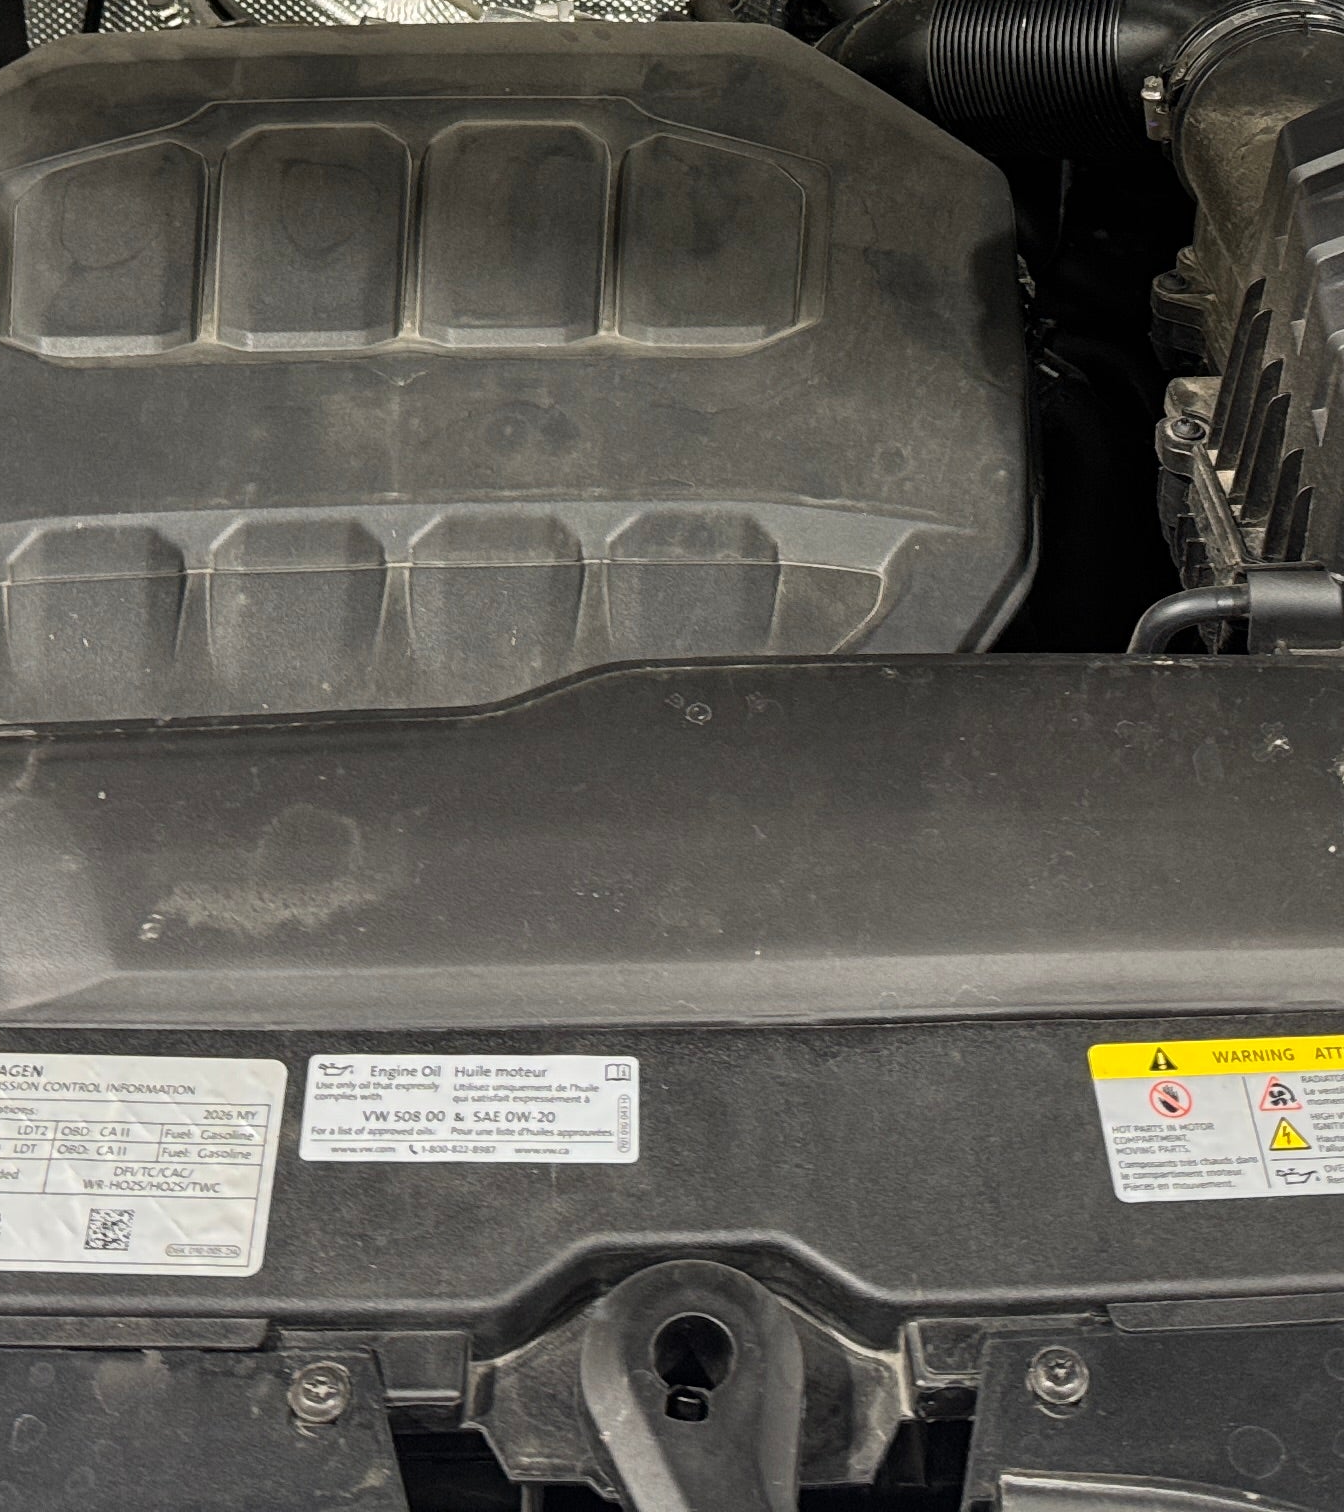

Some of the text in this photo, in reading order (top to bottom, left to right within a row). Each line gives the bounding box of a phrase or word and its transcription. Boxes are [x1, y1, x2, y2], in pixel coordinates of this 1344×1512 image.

[1212, 1048, 1295, 1064] WARNING
[370, 1065, 442, 1080] Engine Oil
[454, 1065, 548, 1078] Huile moteur
[43, 1081, 101, 1094] CONTROL
[106, 1083, 196, 1096] INFORMATION
[335, 1081, 357, 1092] only
[358, 1081, 371, 1089] oil
[372, 1081, 393, 1089] that
[395, 1081, 440, 1092] expressly
[556, 1084, 567, 1092] de
[314, 1092, 357, 1102] complies
[237, 1110, 258, 1121] MY
[362, 1111, 556, 1123] VW 508 00 & SAE 0W-20
[17, 1125, 48, 1136] LDT2
[99, 1126, 117, 1137] CA
[311, 1126, 327, 1135] For
[337, 1126, 352, 1135] list
[355, 1126, 366, 1135] of
[367, 1127, 414, 1137] approved
[451, 1127, 473, 1135] Pour
[1112, 1124, 1131, 1134] HOT
[1134, 1124, 1164, 1133] PARTS
[1179, 1122, 1215, 1131] MOTOR
[200, 1130, 255, 1141] Gasoline
[13, 1143, 38, 1154] LDT
[96, 1145, 114, 1157] CA
[197, 1148, 252, 1159] Gasoline
[1116, 1145, 1156, 1155] MOVING
